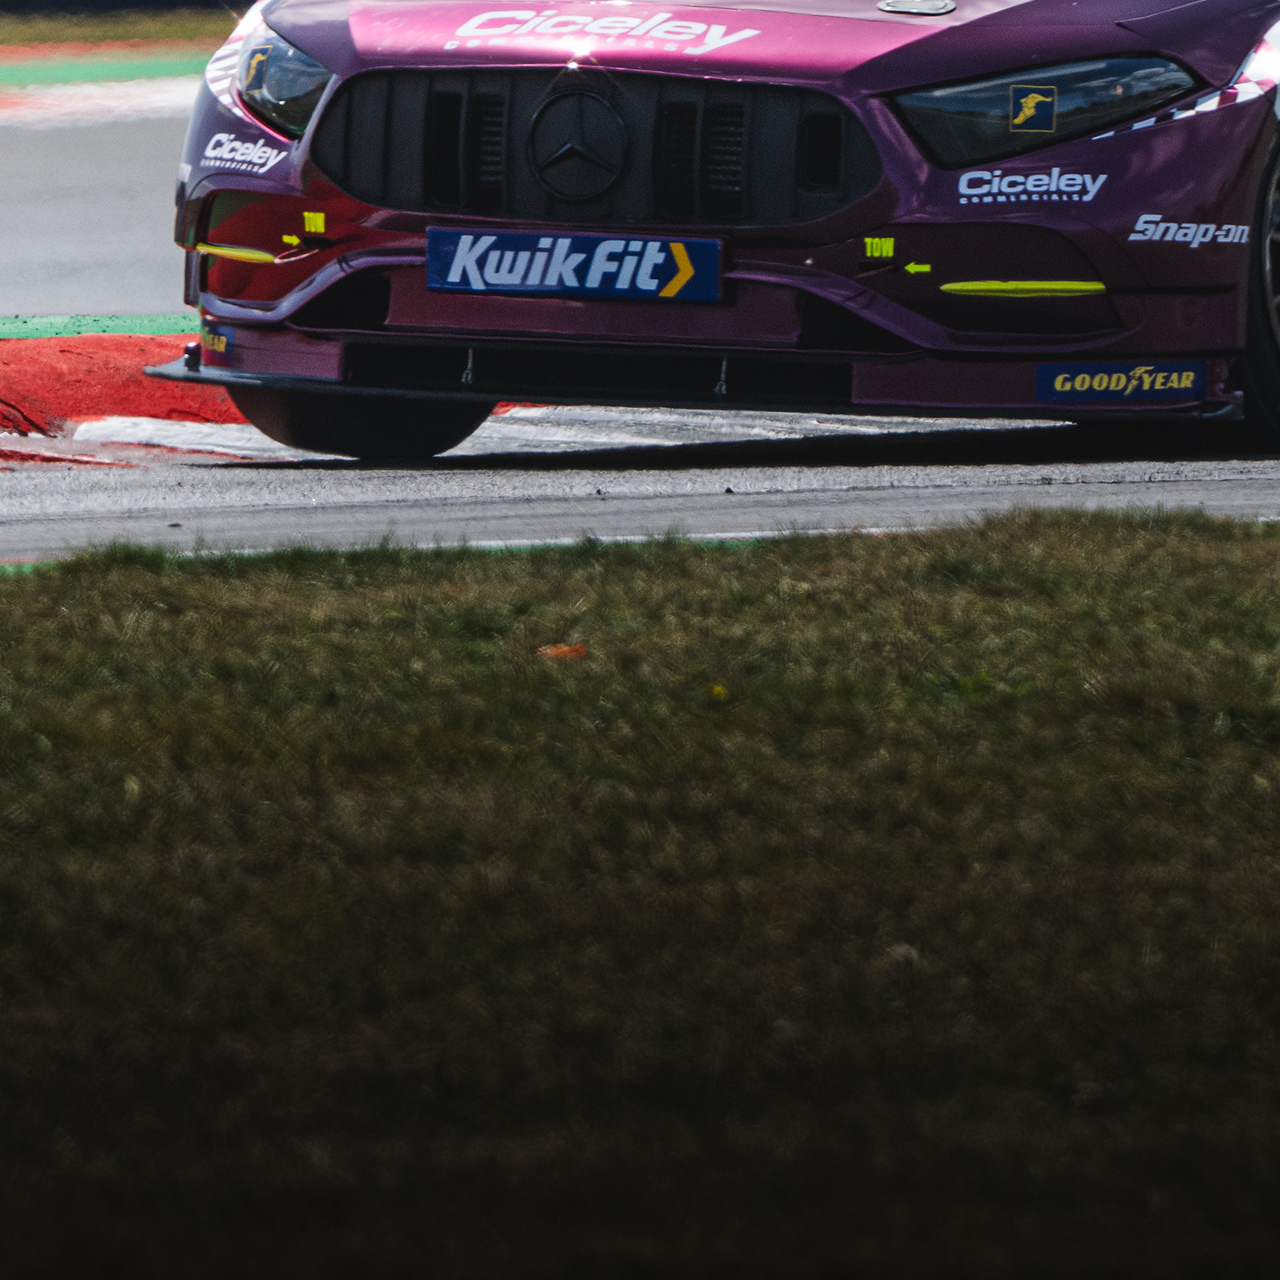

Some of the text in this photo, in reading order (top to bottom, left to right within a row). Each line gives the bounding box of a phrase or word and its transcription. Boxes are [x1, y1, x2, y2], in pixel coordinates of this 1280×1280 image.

[455, 9, 762, 55] Ciceley
[204, 132, 288, 174] Ciceley
[958, 167, 1108, 203] Ciceley
[864, 237, 895, 257] TOW
[1128, 214, 1250, 248] Snap-on
